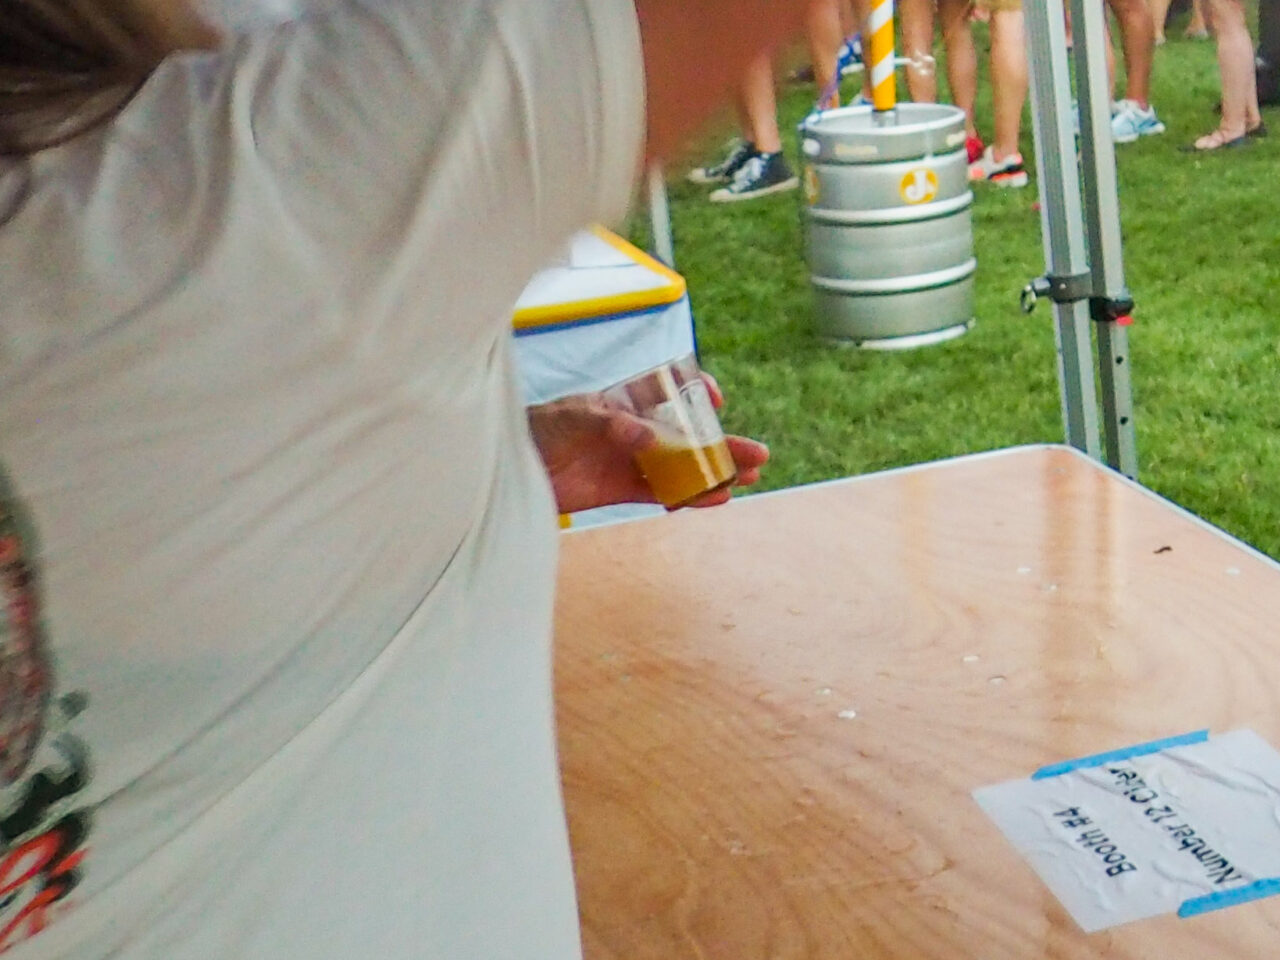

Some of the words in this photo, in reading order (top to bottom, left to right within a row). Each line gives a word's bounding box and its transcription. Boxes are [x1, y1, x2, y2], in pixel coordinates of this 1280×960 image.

[1053, 806, 1093, 830] #4
[1144, 805, 1178, 825] 12
[1074, 828, 1137, 878] Booth
[1162, 823, 1243, 885] Number
